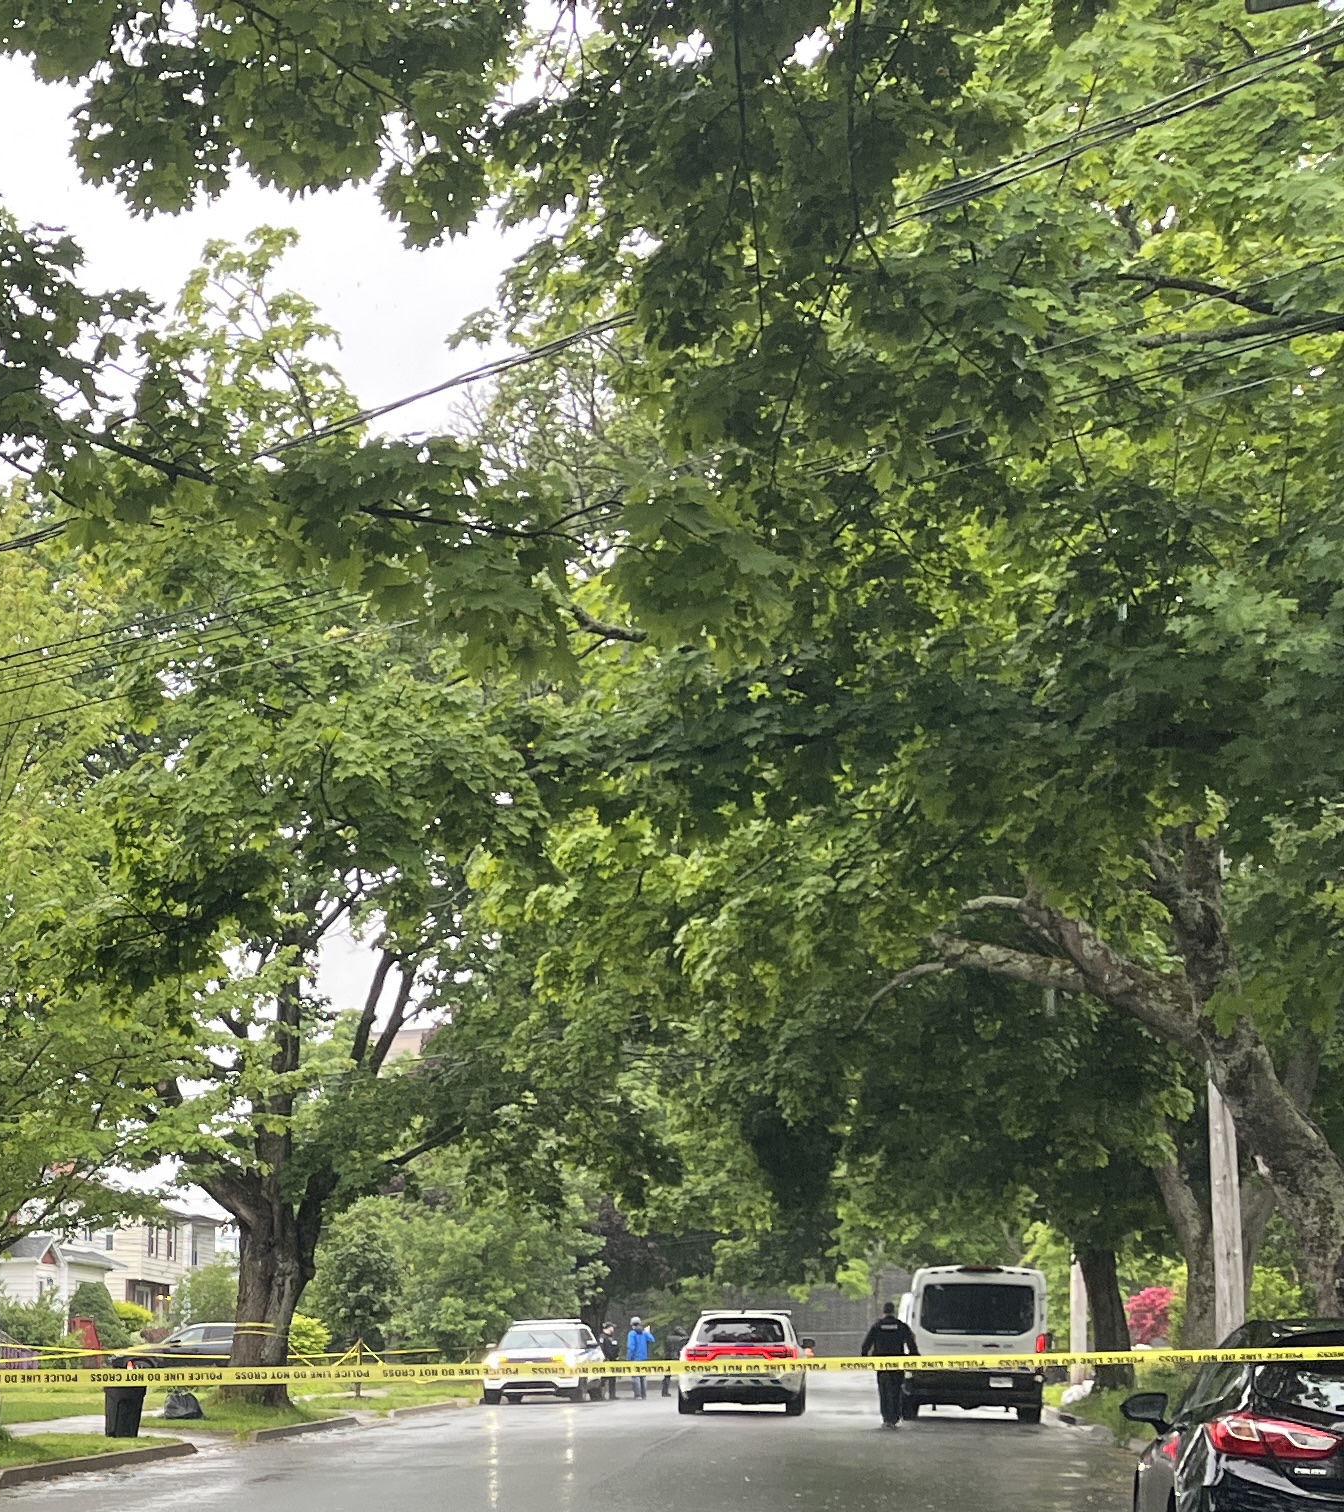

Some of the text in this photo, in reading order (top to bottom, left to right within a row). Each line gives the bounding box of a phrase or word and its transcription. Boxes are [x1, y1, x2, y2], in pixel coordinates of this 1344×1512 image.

[21, 1374, 41, 1382] LINE
[44, 1374, 78, 1382] POLICE
[148, 1373, 160, 1381] DO
[164, 1373, 184, 1381] LINE
[235, 1372, 267, 1380] CROSS
[335, 1370, 370, 1378] POLICE
[5, 1375, 17, 1383] DO
